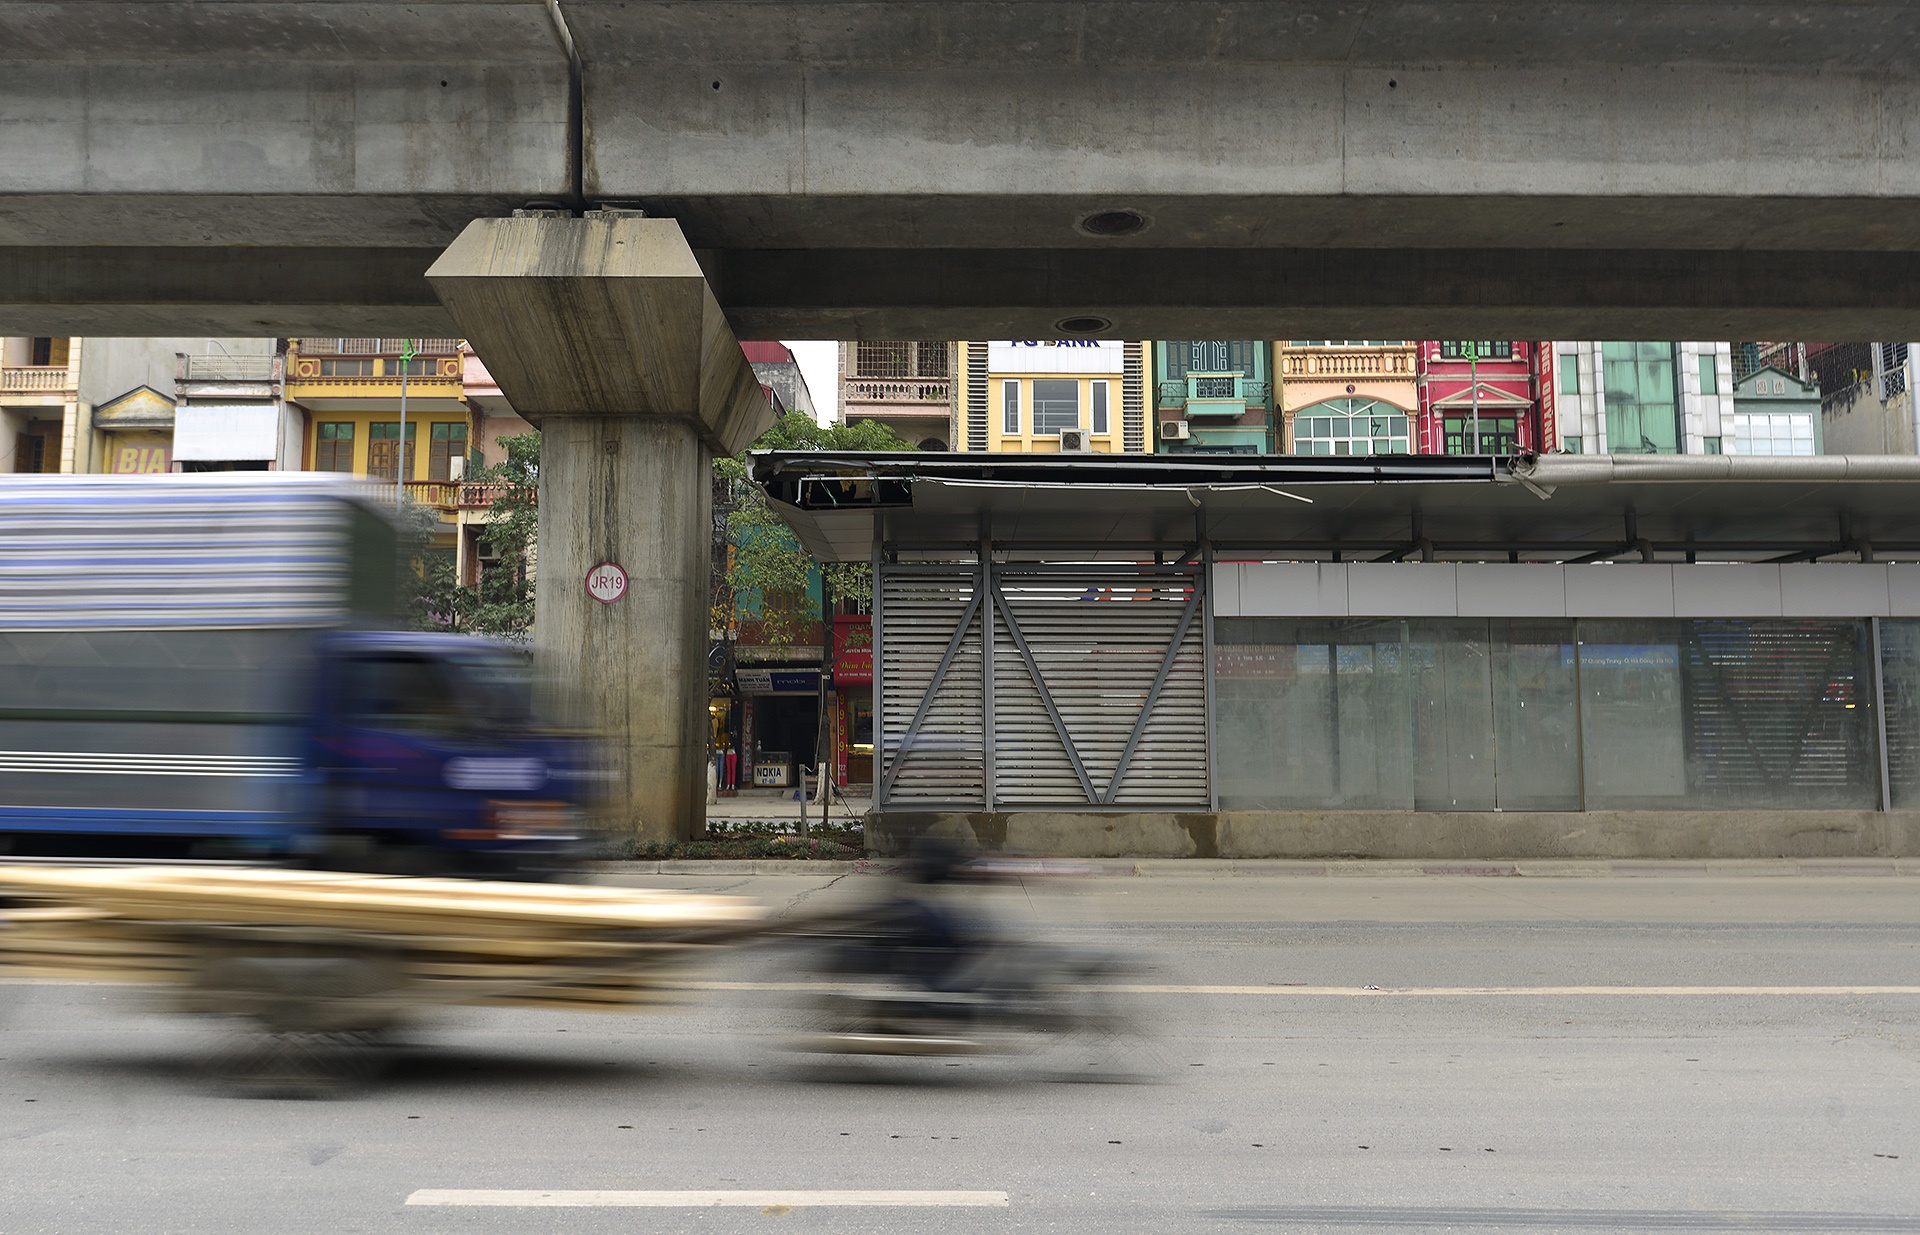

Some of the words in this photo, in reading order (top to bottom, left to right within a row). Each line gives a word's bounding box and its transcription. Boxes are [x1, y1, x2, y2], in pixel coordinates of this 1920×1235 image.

[118, 448, 166, 474] BIA
[592, 576, 622, 589] JR19
[756, 767, 782, 777] NOKIA
